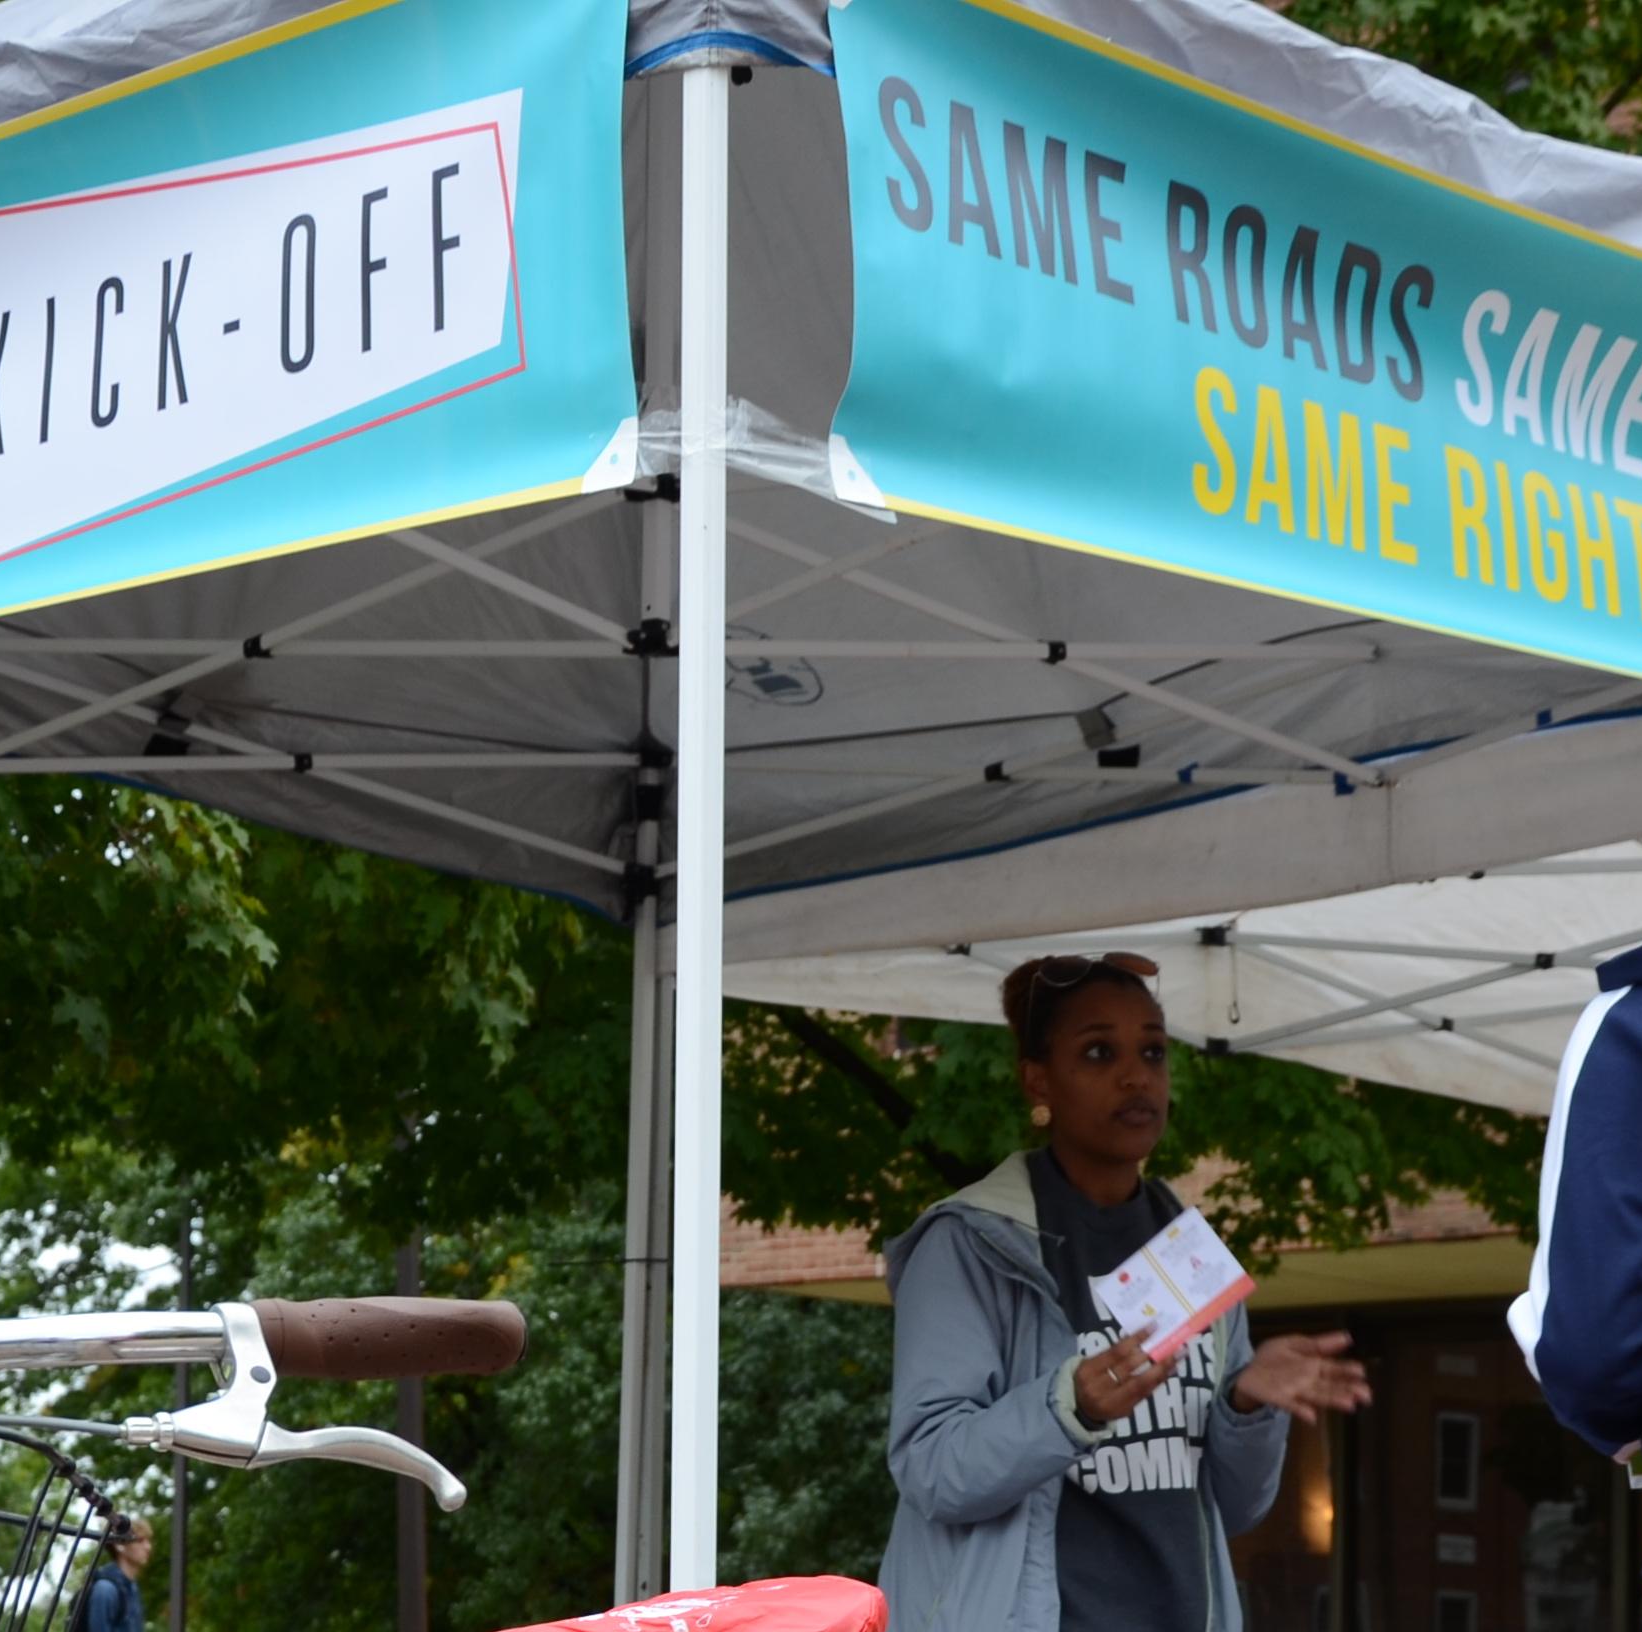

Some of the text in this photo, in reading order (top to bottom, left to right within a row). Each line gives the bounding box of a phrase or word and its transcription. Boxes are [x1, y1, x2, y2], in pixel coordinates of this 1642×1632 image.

[878, 76, 1135, 306] SAME
[1166, 180, 1435, 402] ROADS
[1192, 366, 1418, 566] SAME
